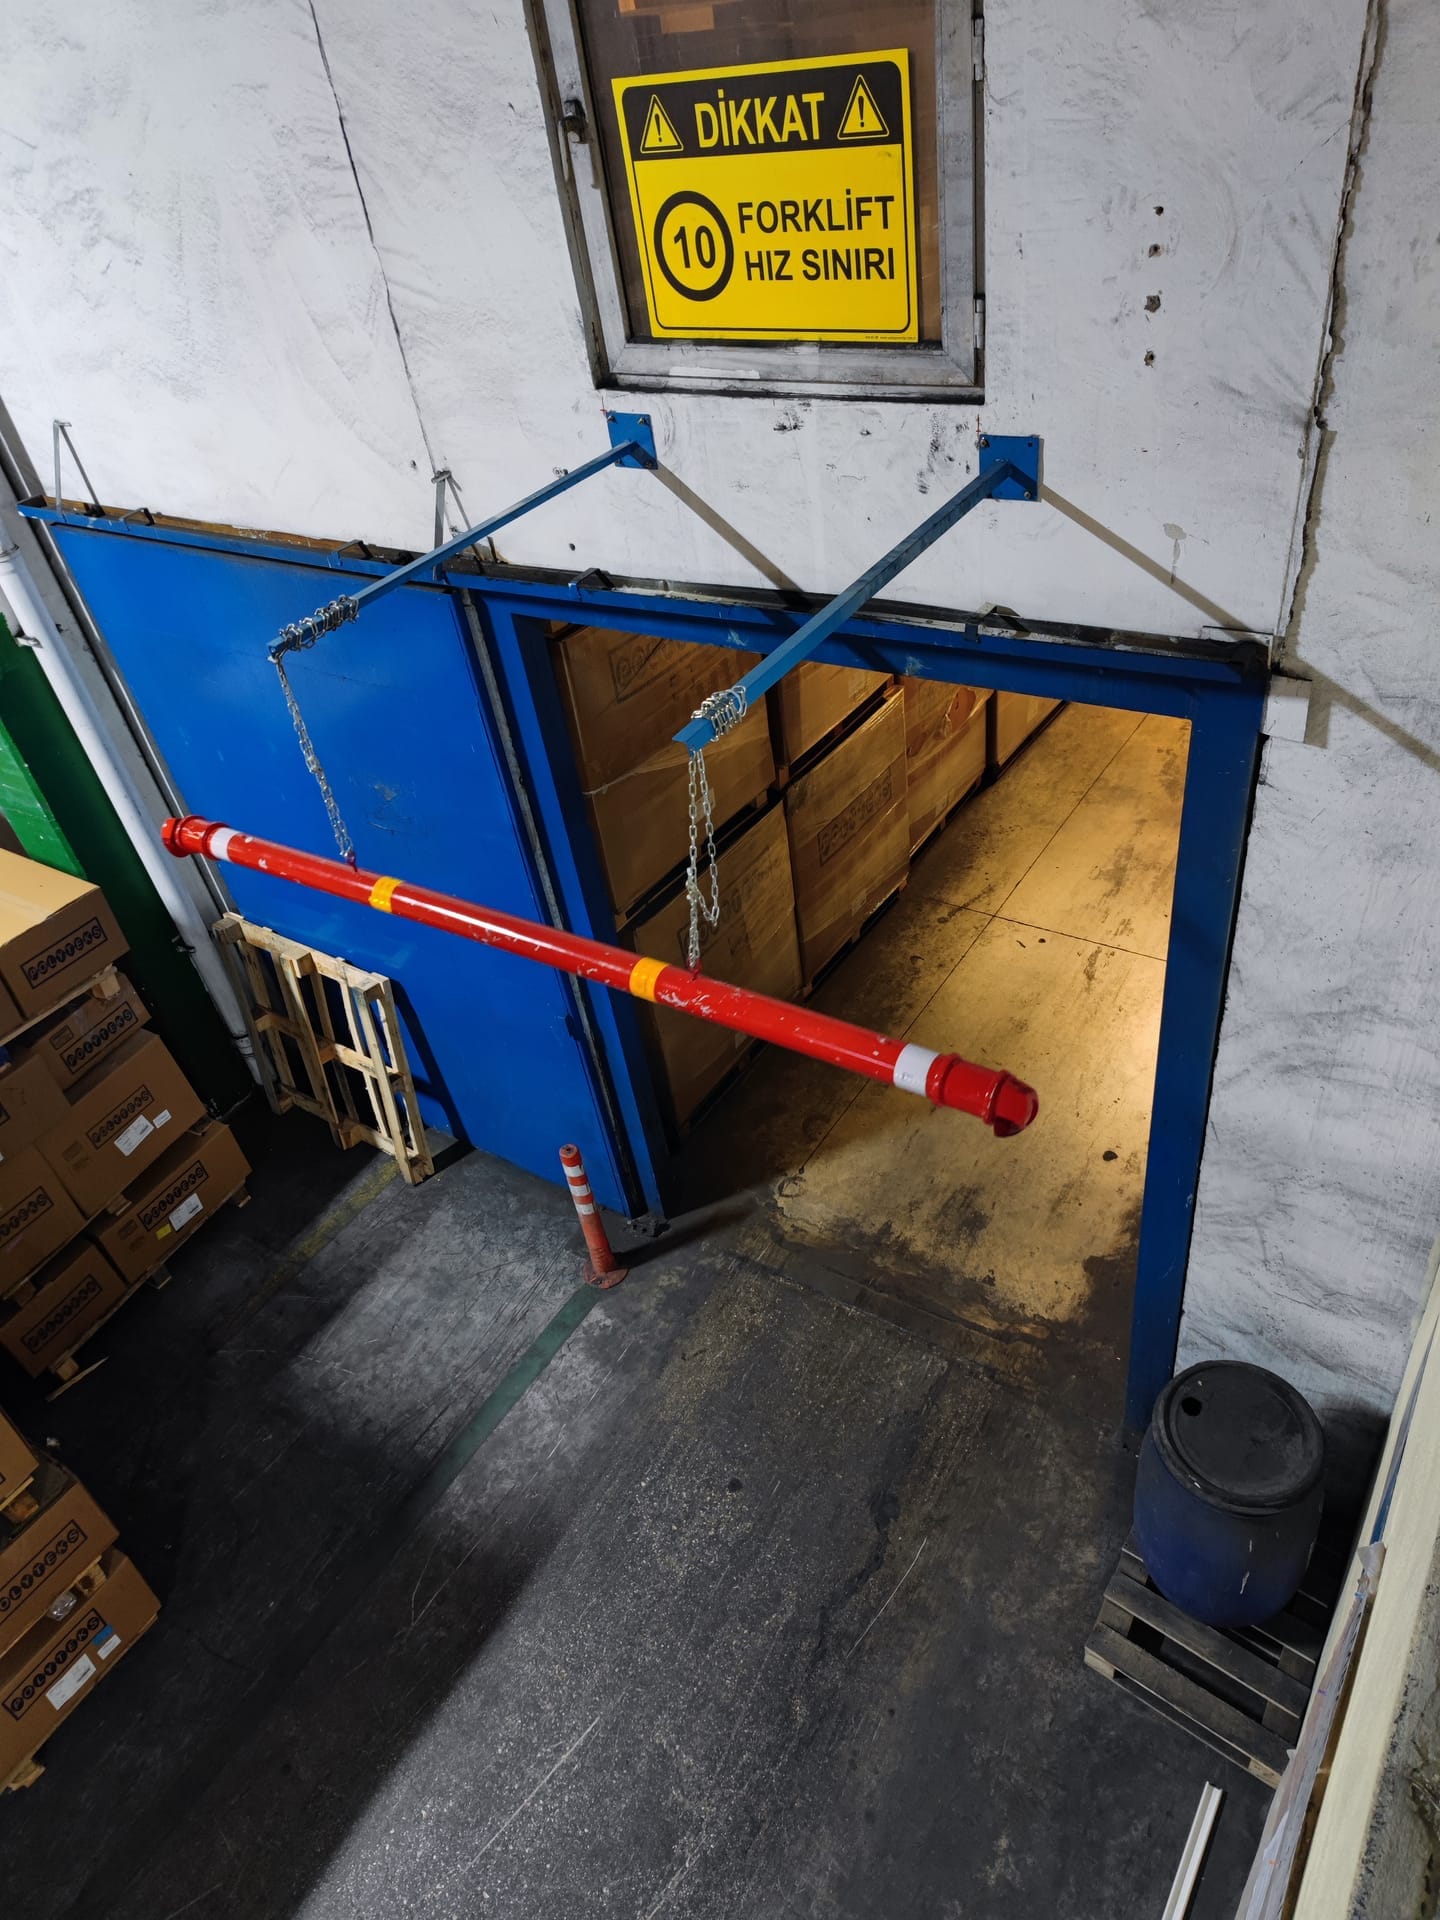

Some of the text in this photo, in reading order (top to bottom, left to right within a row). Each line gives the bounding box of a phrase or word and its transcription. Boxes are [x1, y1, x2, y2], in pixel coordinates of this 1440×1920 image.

[694, 88, 825, 149] DİKKAT
[737, 188, 895, 234] FORKLİFT
[673, 225, 716, 269] 10
[745, 248, 895, 281] HIZ SINIRI
[28, 926, 102, 980] POLYTEKS
[11, 1616, 99, 1711] POLYTEKS
